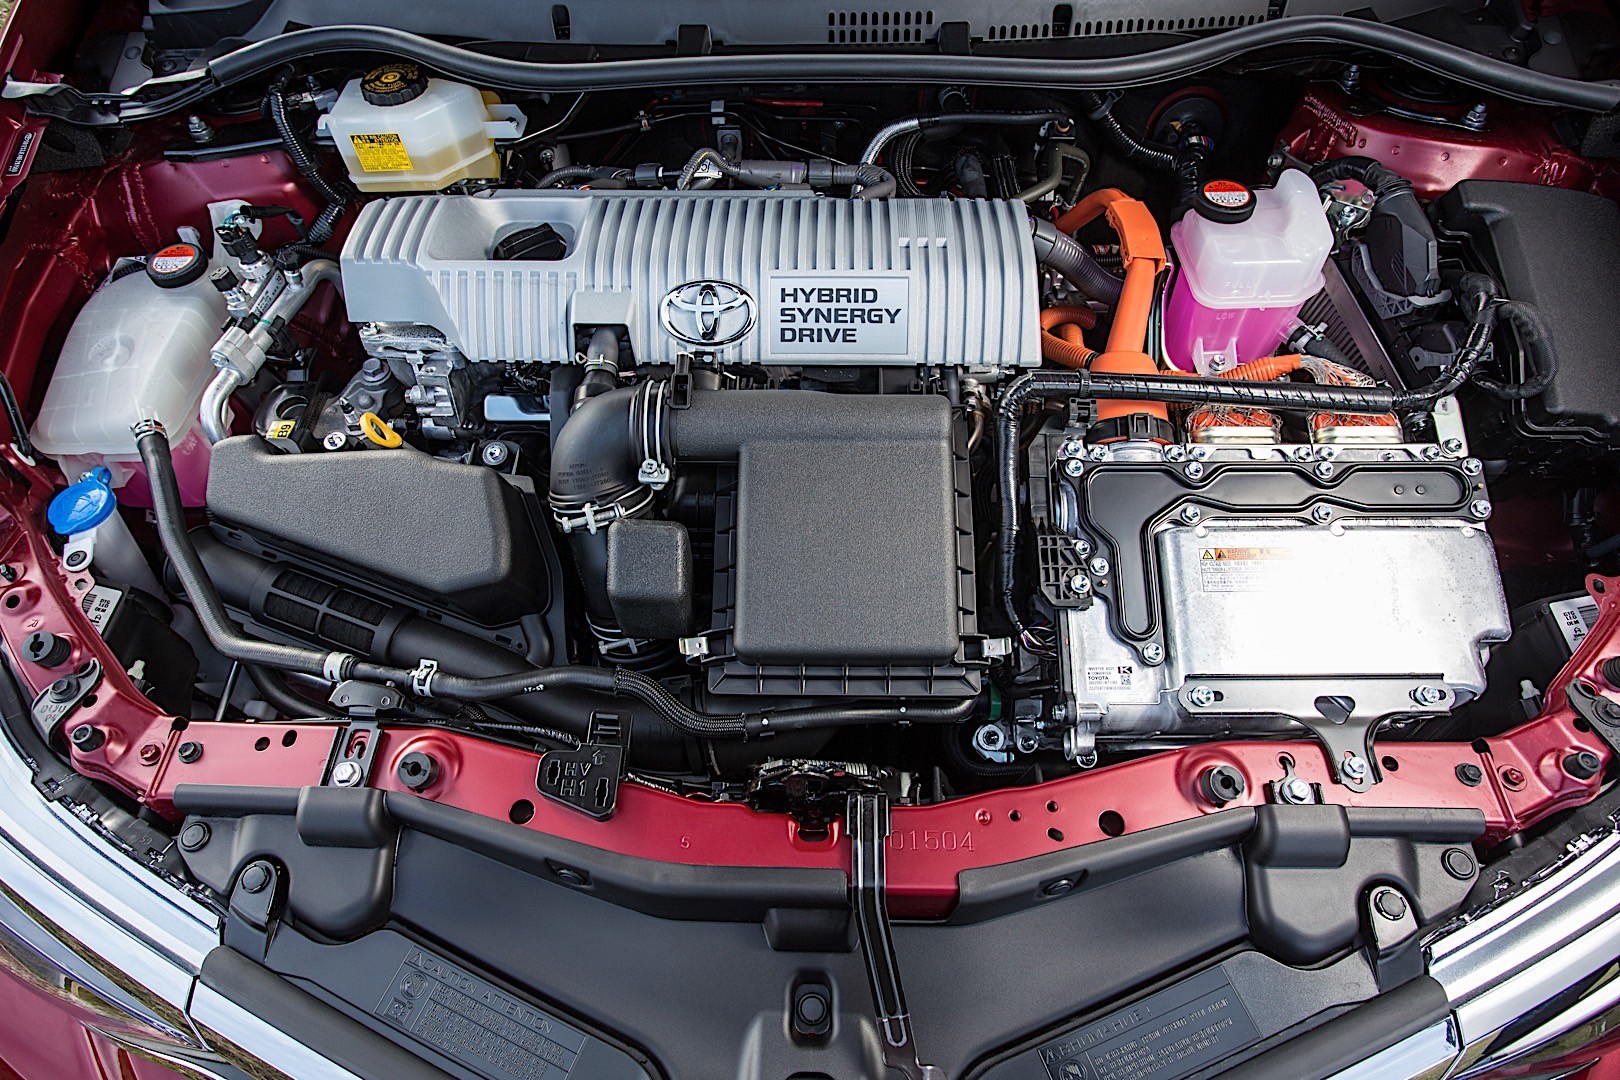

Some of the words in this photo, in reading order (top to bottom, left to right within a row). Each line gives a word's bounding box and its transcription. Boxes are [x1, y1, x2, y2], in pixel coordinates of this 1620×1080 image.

[780, 287, 878, 304] HYBRID
[780, 307, 902, 324] SYNERGY
[1216, 312, 1236, 320] LOW
[780, 327, 857, 343] DRIVE
[564, 762, 592, 777] HV
[560, 779, 587, 797] H1
[680, 836, 690, 849] 5
[890, 829, 975, 852] 01504
[421, 957, 478, 995] CAUTION
[480, 990, 554, 1034] ATTENTION
[1058, 1009, 1144, 1055] ВНИМАНИЕ
